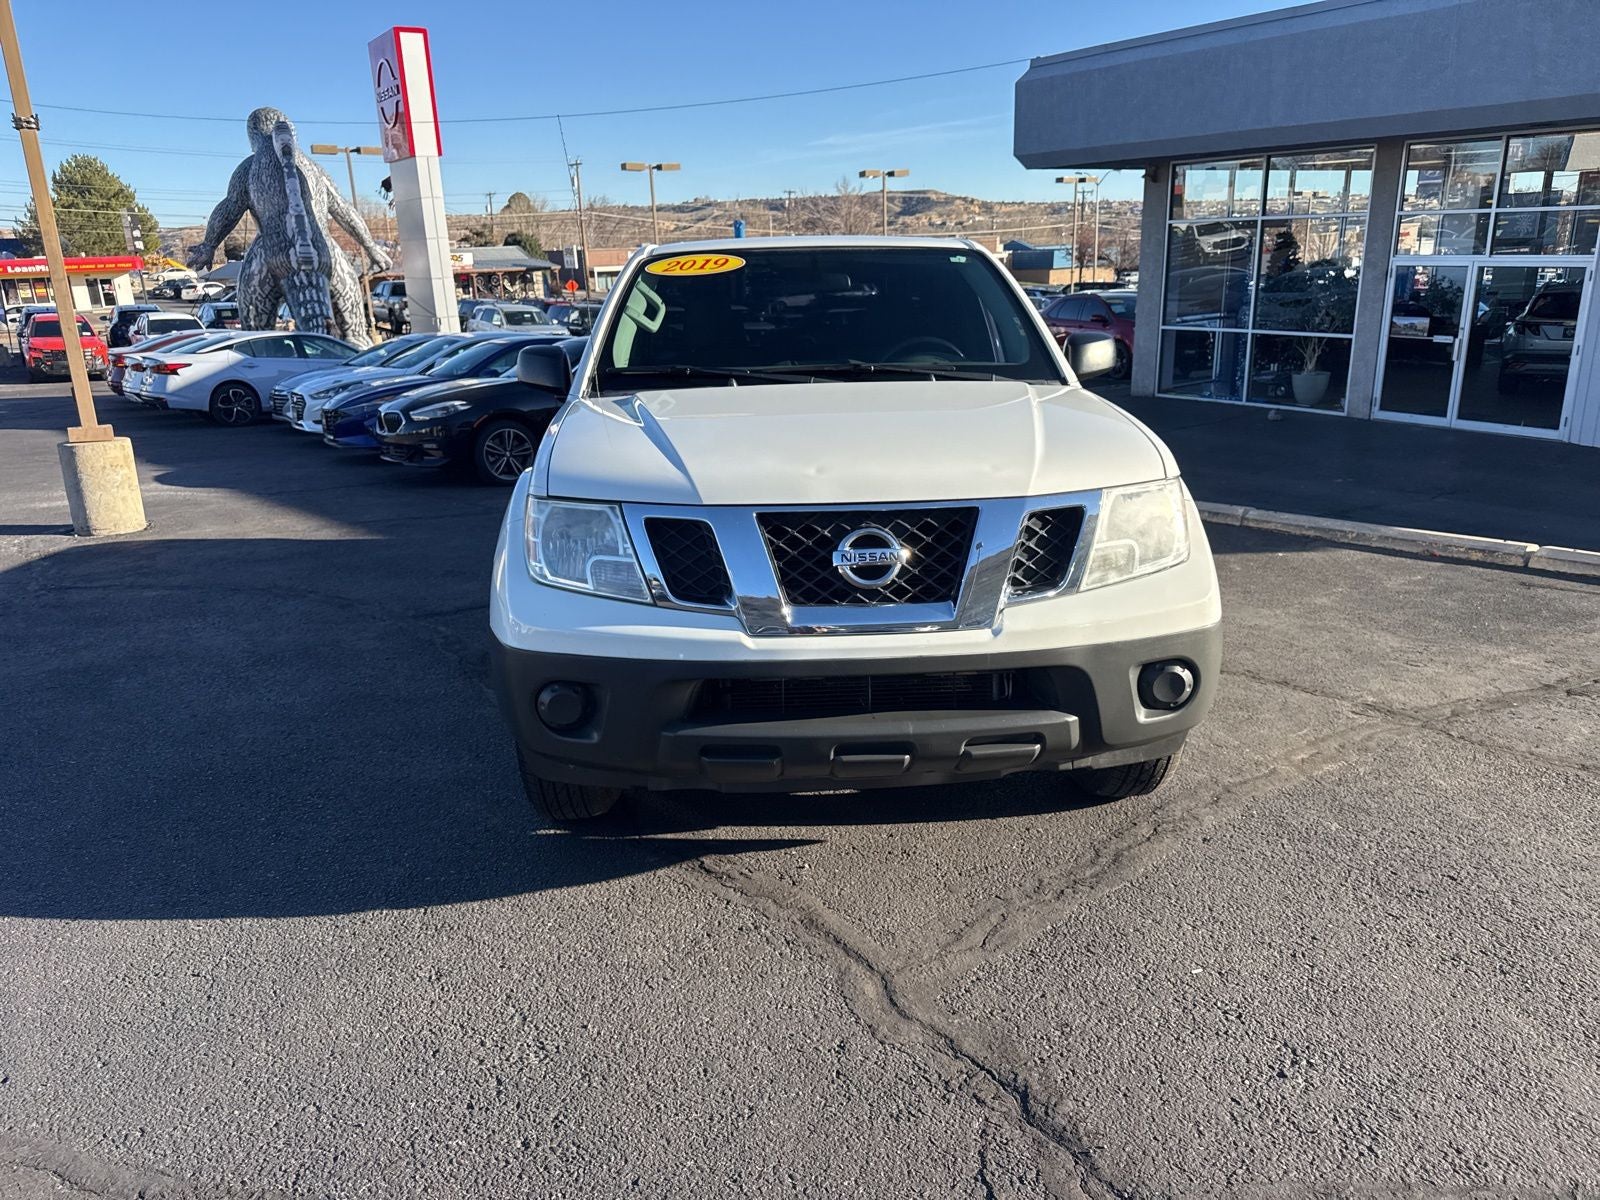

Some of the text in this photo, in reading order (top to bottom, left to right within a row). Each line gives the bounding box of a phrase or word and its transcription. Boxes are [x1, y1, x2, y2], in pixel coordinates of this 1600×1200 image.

[377, 84, 400, 103] NISSAN
[662, 257, 730, 272] 2019
[841, 551, 899, 562] NISSAN
